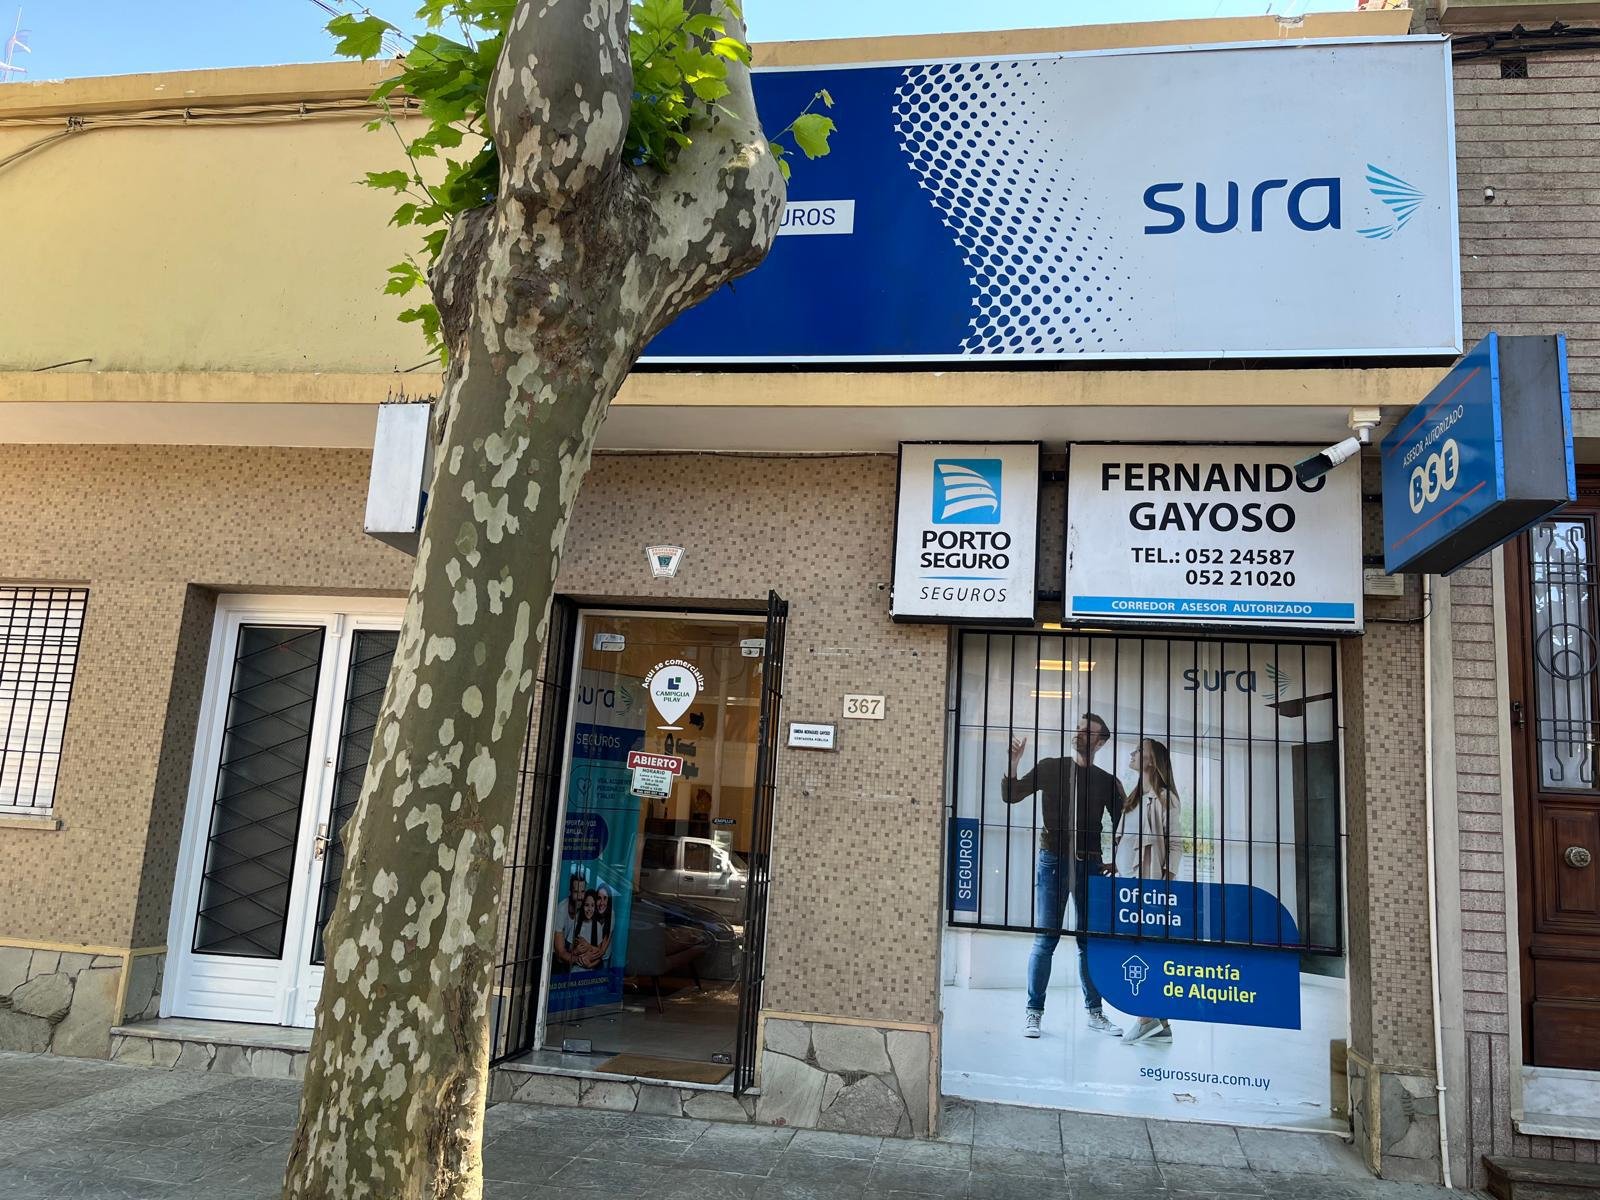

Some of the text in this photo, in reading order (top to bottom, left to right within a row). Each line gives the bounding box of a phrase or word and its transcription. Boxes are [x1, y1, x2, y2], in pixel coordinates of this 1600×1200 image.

[1143, 177, 1342, 235] sura
[780, 207, 836, 227] UROS
[1403, 404, 1464, 469] ASESOR AUTORIZADO
[1410, 440, 1458, 512] BSE
[1129, 502, 1296, 533] GAYOSO
[921, 530, 1011, 550] PORTO
[920, 552, 1010, 570] SEGURO
[1131, 548, 1295, 565] TEL.: 052 24587
[1185, 570, 1296, 587] 052 21020
[919, 586, 1007, 602] SEGUROS
[1112, 600, 1313, 615] CORREDOR ASESOR AUTORIZADO
[664, 659, 705, 692] comercializa
[1183, 668, 1256, 693] sura
[847, 698, 881, 715] 367
[633, 755, 678, 769] ABIERTO
[958, 829, 973, 900] SEGUROS
[1119, 908, 1182, 927] Colonia
[1163, 960, 1241, 981] Garantía
[1163, 981, 1257, 1004] de Alquiler
[1140, 1067, 1271, 1092] segurossura.com.uy
